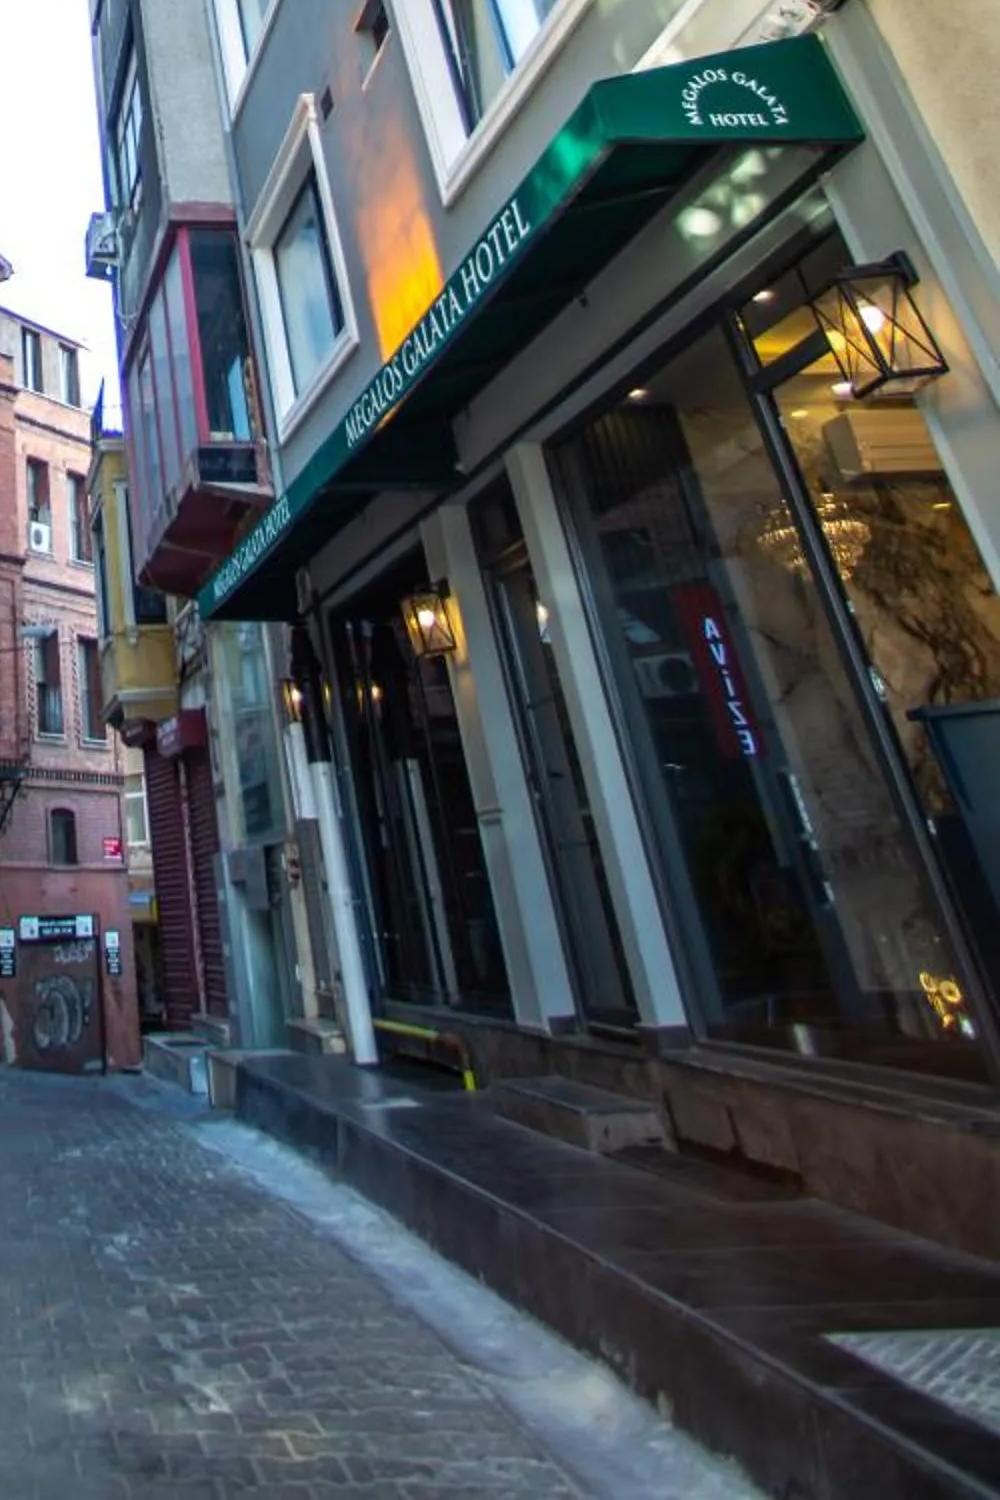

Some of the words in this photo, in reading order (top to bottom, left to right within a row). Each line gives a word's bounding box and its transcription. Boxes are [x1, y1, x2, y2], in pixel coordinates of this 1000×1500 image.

[682, 69, 728, 125] MEGALOS
[732, 71, 789, 125] GALATA
[708, 112, 770, 128] HOTEL
[344, 356, 404, 448] MEGALOS
[401, 285, 465, 377] GALATA
[459, 198, 531, 303] HOTEL
